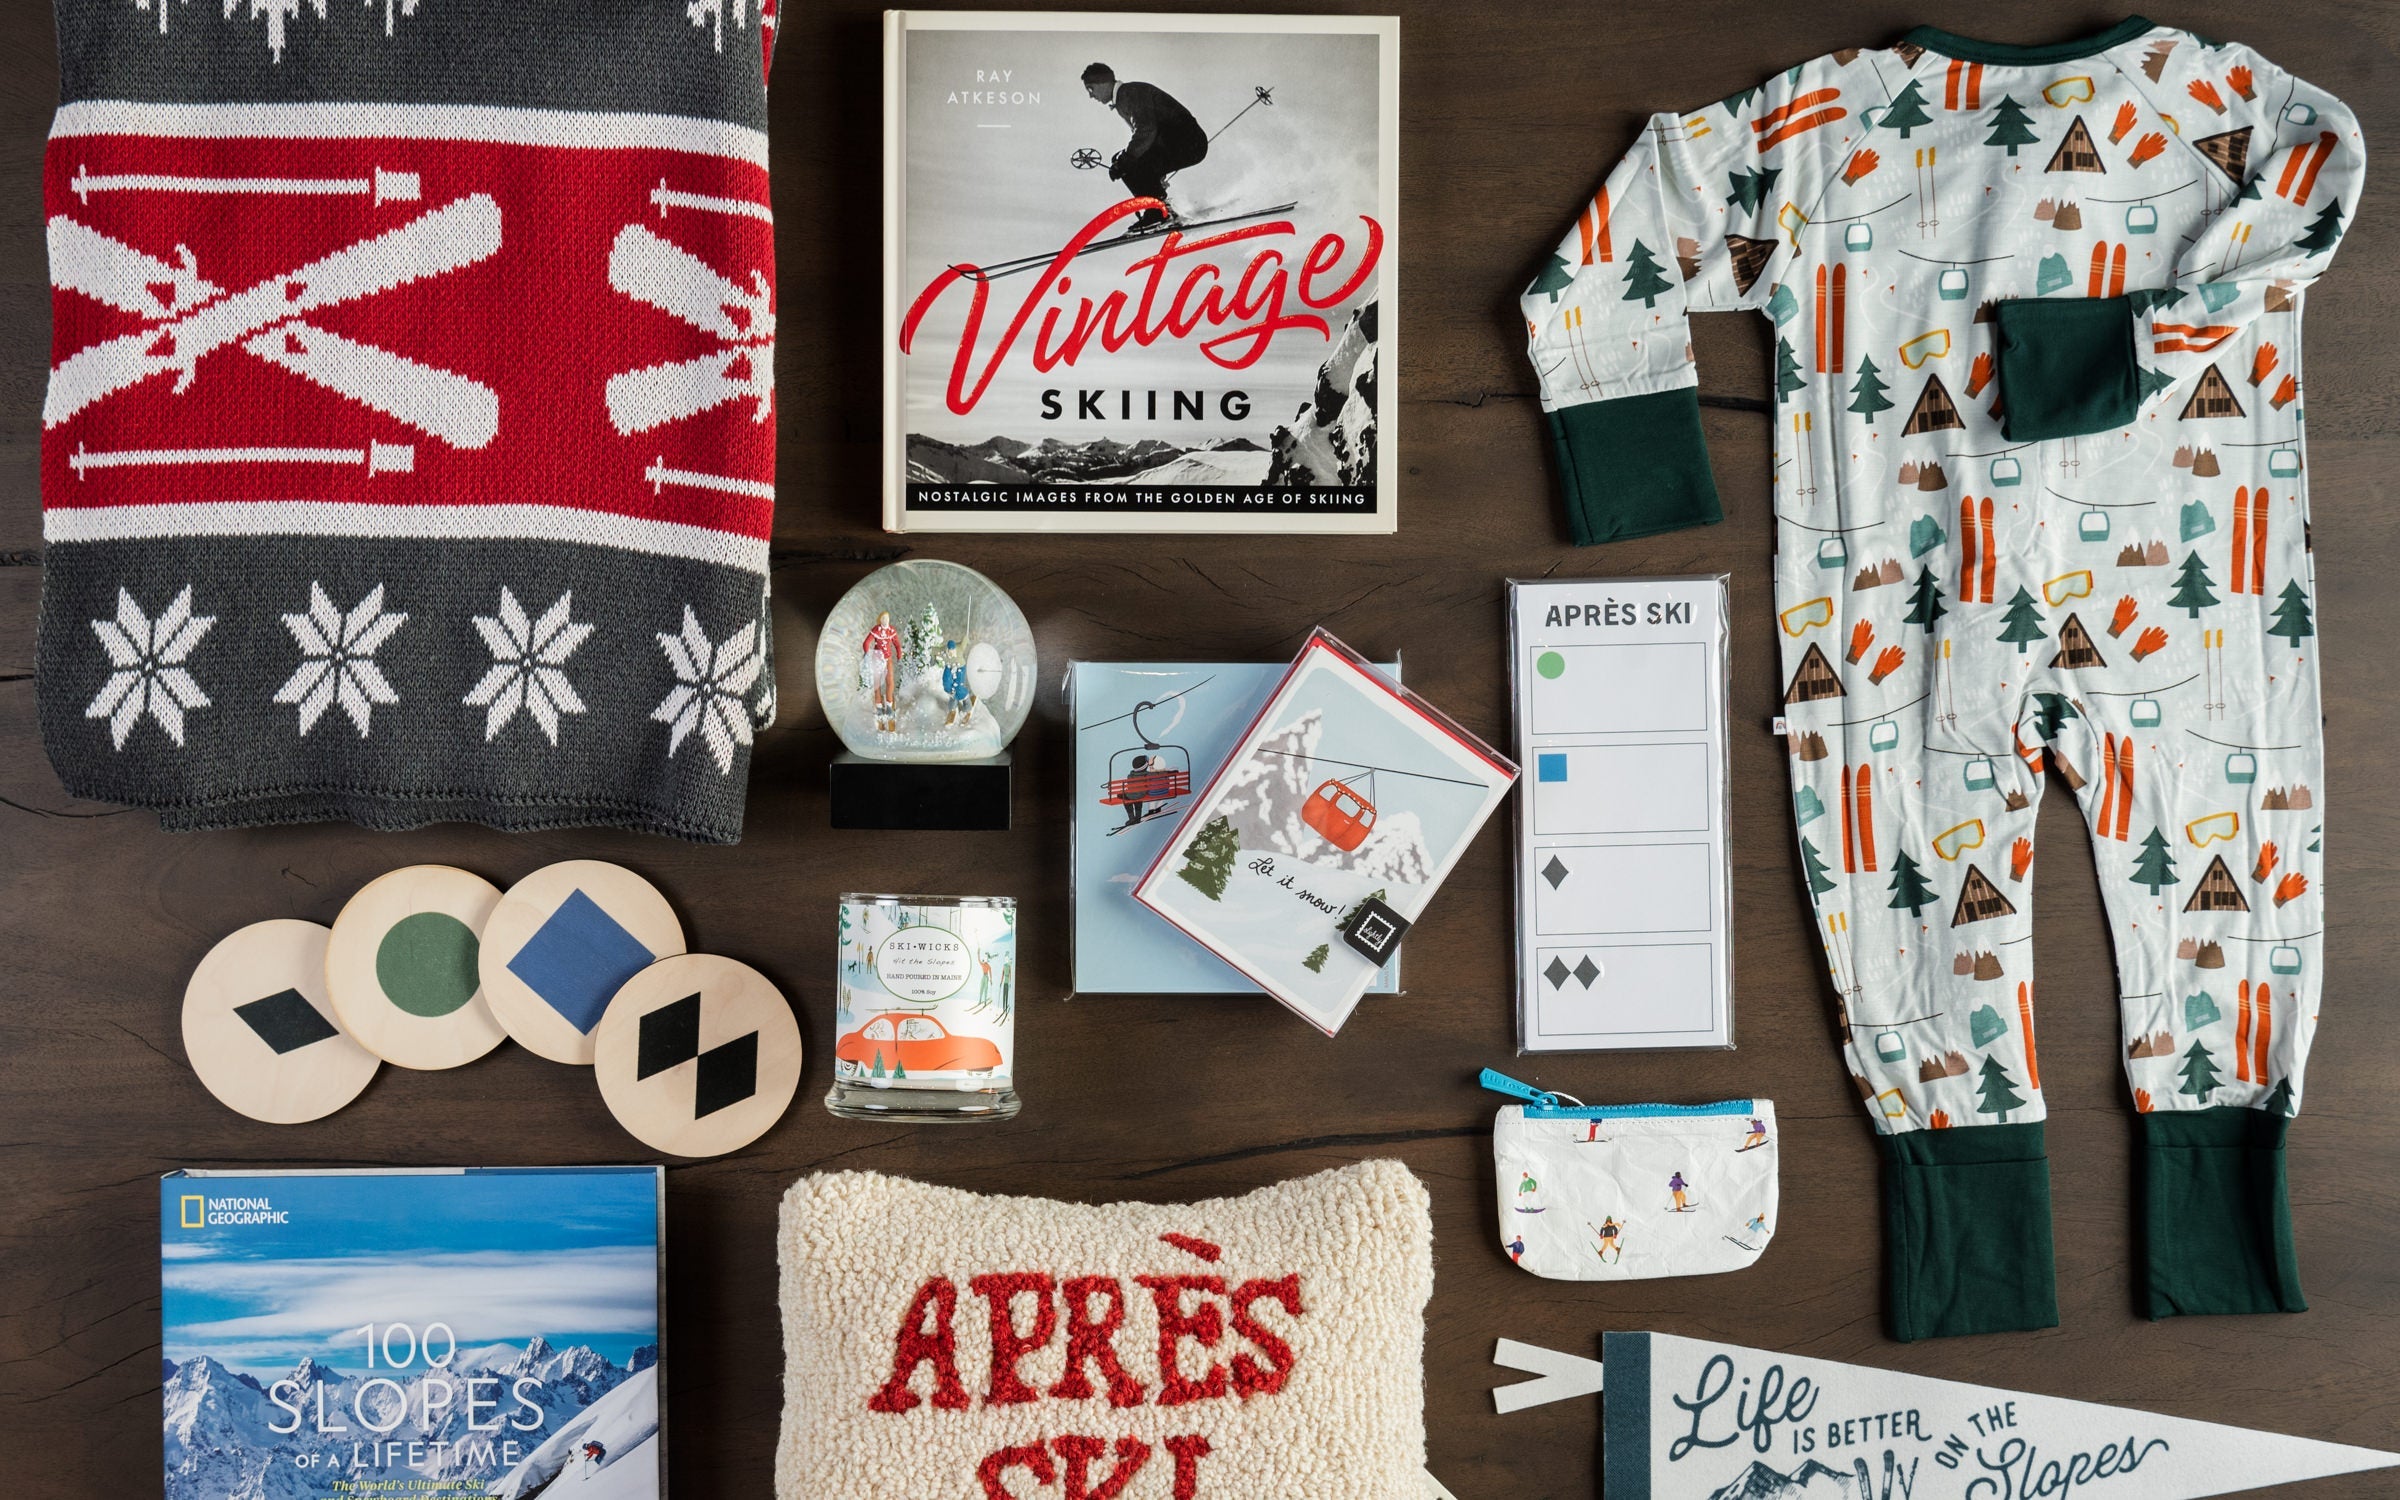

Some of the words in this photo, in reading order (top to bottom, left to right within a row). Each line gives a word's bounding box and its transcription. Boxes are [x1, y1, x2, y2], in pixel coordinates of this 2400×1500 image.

[976, 69, 1013, 83] RAY
[946, 90, 1041, 105] ATKESON
[899, 195, 1384, 415] Vintage
[1040, 389, 1252, 421] SKIING
[918, 491, 1008, 503] NOSTALGIC
[1016, 491, 1077, 503] IMAGES
[1085, 492, 1128, 503] FROM
[1135, 492, 1163, 503] THE
[1171, 492, 1235, 504] GOLDEN
[1243, 493, 1274, 504] AGE
[1282, 493, 1302, 504] OF
[1309, 493, 1365, 505] SKIING
[1545, 597, 1637, 627] APRÈS
[1646, 602, 1690, 625] SKI
[1248, 857, 1275, 876] Let
[1276, 874, 1295, 889] it
[909, 957, 923, 965] the
[207, 1211, 289, 1224] GEOGRAPHIC
[208, 1197, 272, 1211] NATIONAL
[868, 1232, 1303, 1413] APRÈS
[356, 1321, 456, 1369] 100
[268, 1377, 545, 1434] SLOPES
[1669, 1354, 1820, 1462] Life
[1793, 1427, 1815, 1454] IS
[1827, 1409, 1932, 1448] BETTER
[1934, 1433, 1969, 1469] ON
[1967, 1401, 2017, 1437] THE
[295, 1454, 320, 1469] OF
[327, 1454, 340, 1468] A
[354, 1440, 519, 1468] LIFETIME
[1965, 1436, 2169, 1500] Slopes
[332, 1480, 356, 1491] The
[408, 1479, 462, 1490] Ultimate
[465, 1478, 485, 1490] Ski
